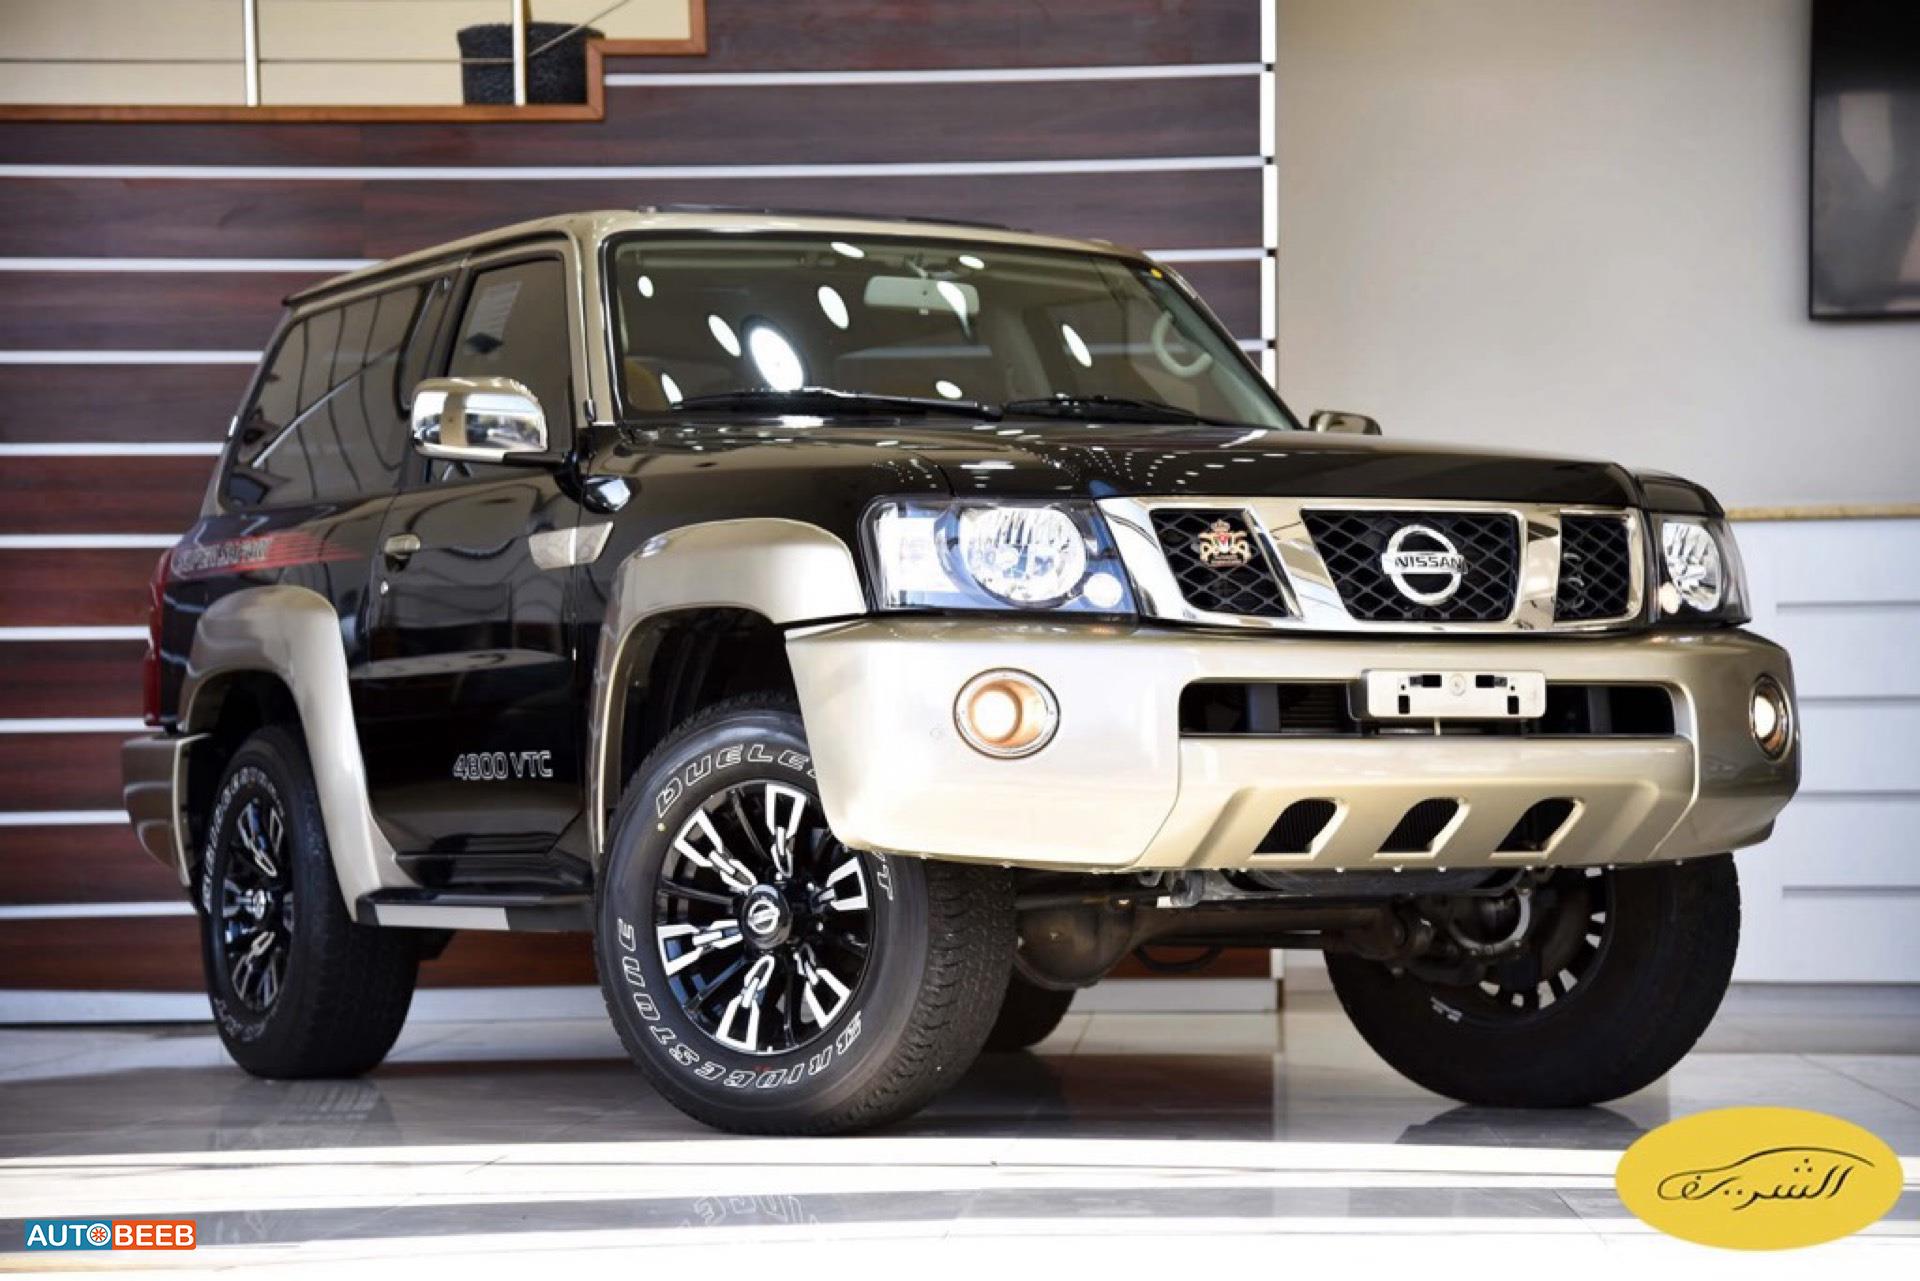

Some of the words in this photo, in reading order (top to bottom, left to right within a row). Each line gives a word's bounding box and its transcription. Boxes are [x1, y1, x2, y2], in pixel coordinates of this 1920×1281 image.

[1394, 555, 1463, 571] NISSAN
[453, 751, 508, 780] 4800
[510, 750, 553, 778] VTC
[656, 743, 816, 818] DUELE
[617, 918, 863, 1090] BRIDGESTONE
